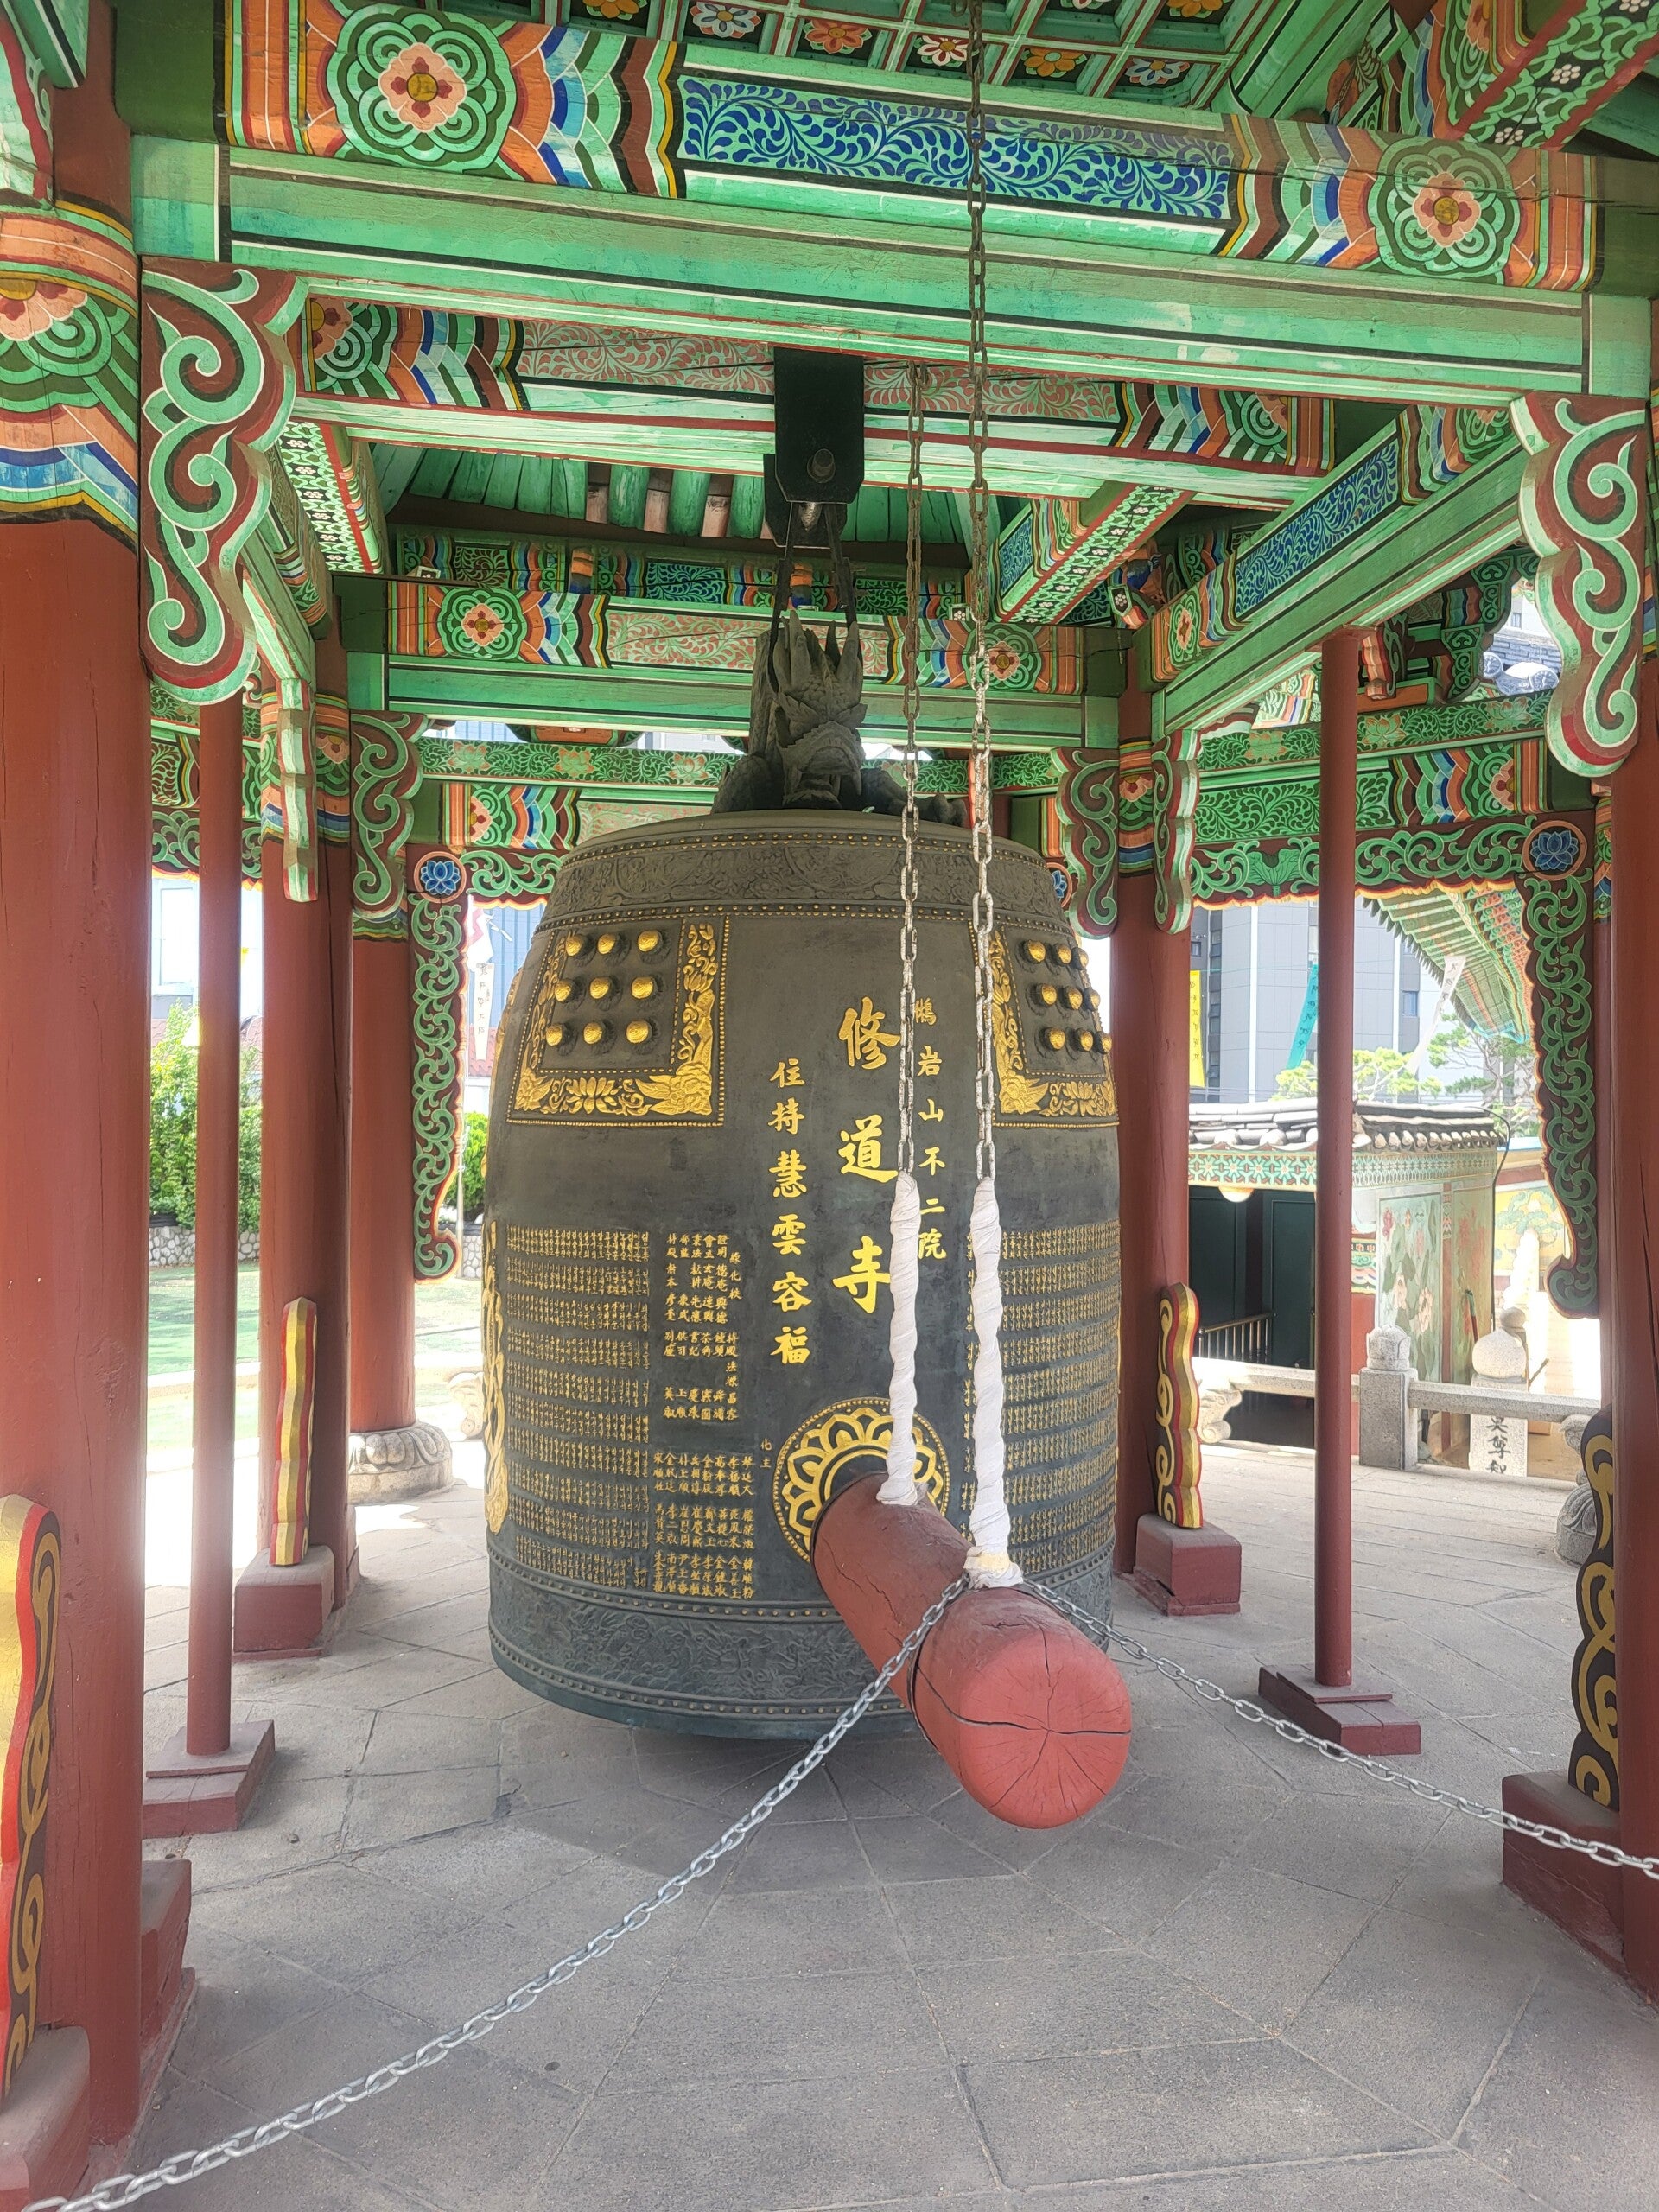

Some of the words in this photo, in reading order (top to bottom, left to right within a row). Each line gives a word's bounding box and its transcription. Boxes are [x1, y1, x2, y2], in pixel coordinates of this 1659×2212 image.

[769, 1058, 811, 1366] 住持慧雲容福
[833, 996, 901, 1314] 修道寺
